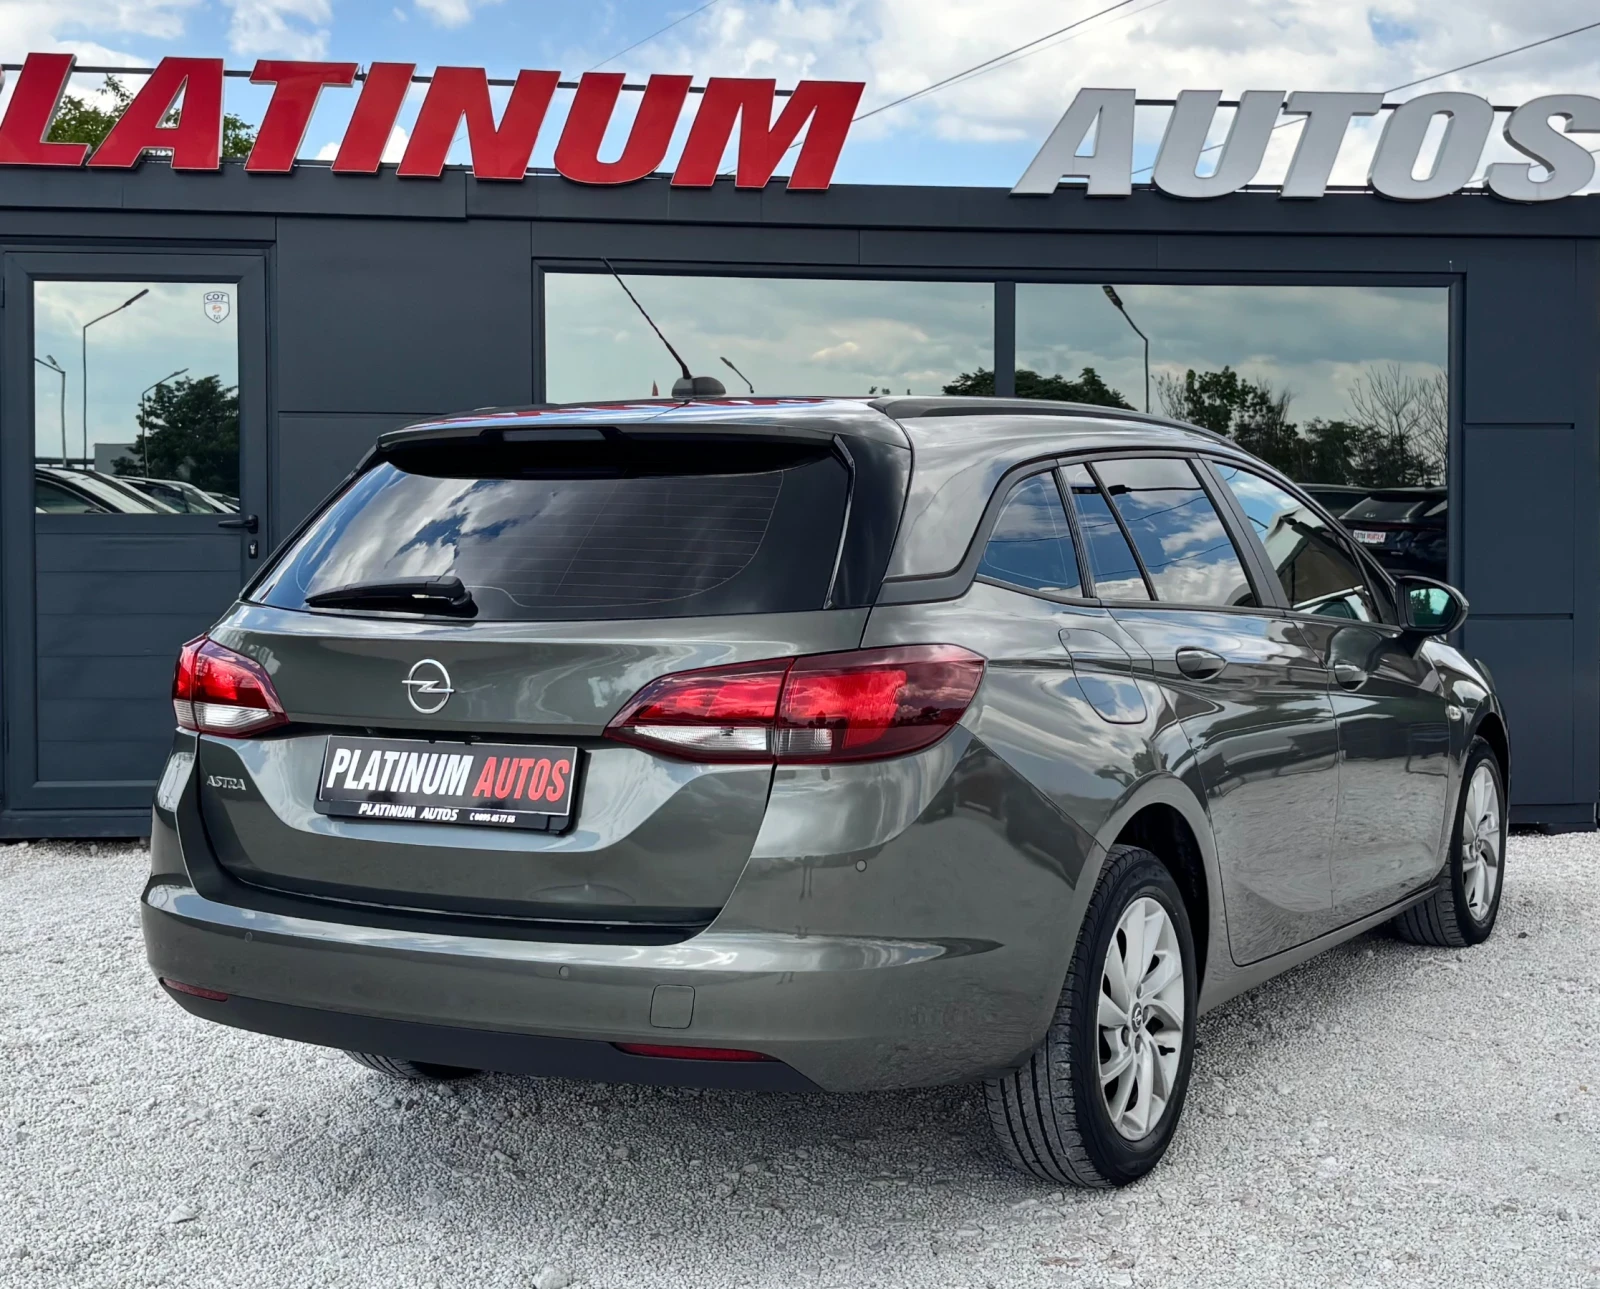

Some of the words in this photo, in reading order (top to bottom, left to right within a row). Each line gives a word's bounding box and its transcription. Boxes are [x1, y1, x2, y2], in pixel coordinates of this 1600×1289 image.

[0, 52, 866, 191] LATINUM
[1009, 87, 1600, 203] AUTOS
[206, 775, 247, 791] ASTRA
[326, 748, 474, 797] PLATINUM
[472, 756, 569, 802] AUTOS
[358, 803, 417, 819] PLATINUM
[420, 807, 459, 821] AUTOS
